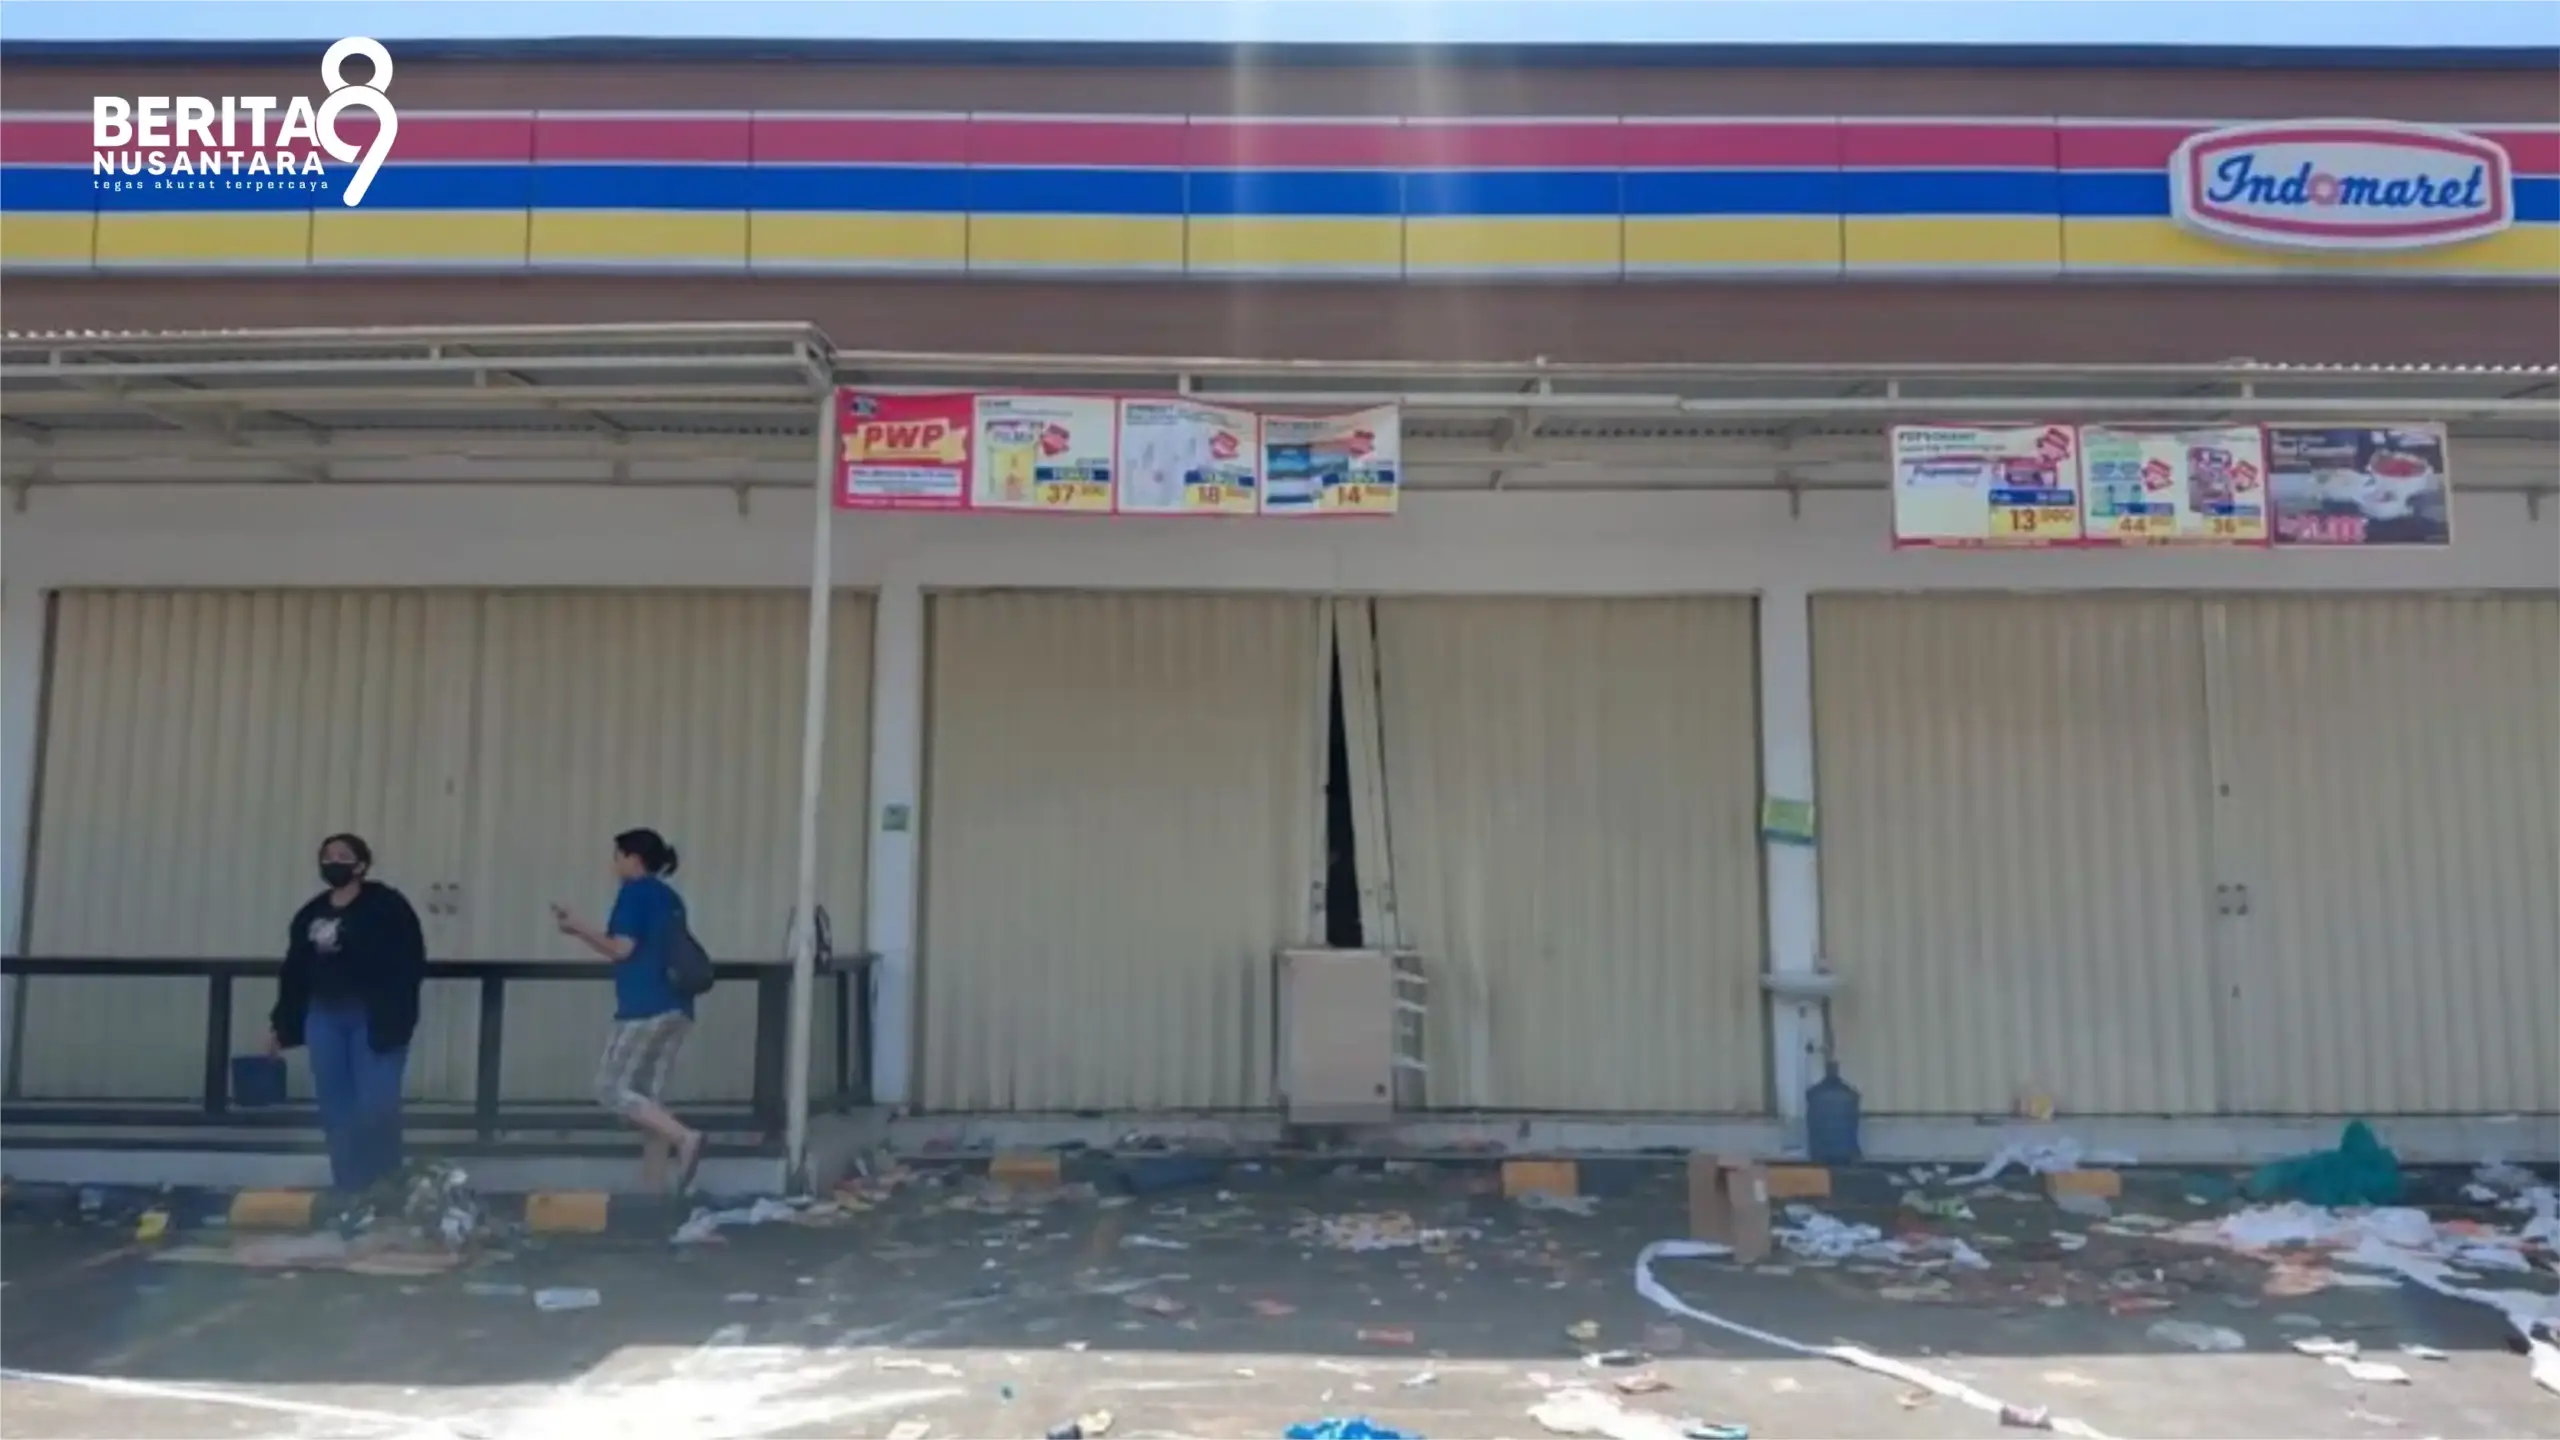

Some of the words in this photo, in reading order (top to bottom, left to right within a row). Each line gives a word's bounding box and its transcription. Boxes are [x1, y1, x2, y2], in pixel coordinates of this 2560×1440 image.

[2206, 153, 2488, 208] Indomaret
[863, 423, 945, 449] PWP
[1046, 484, 1075, 504] 37
[2009, 509, 2037, 532] 13
